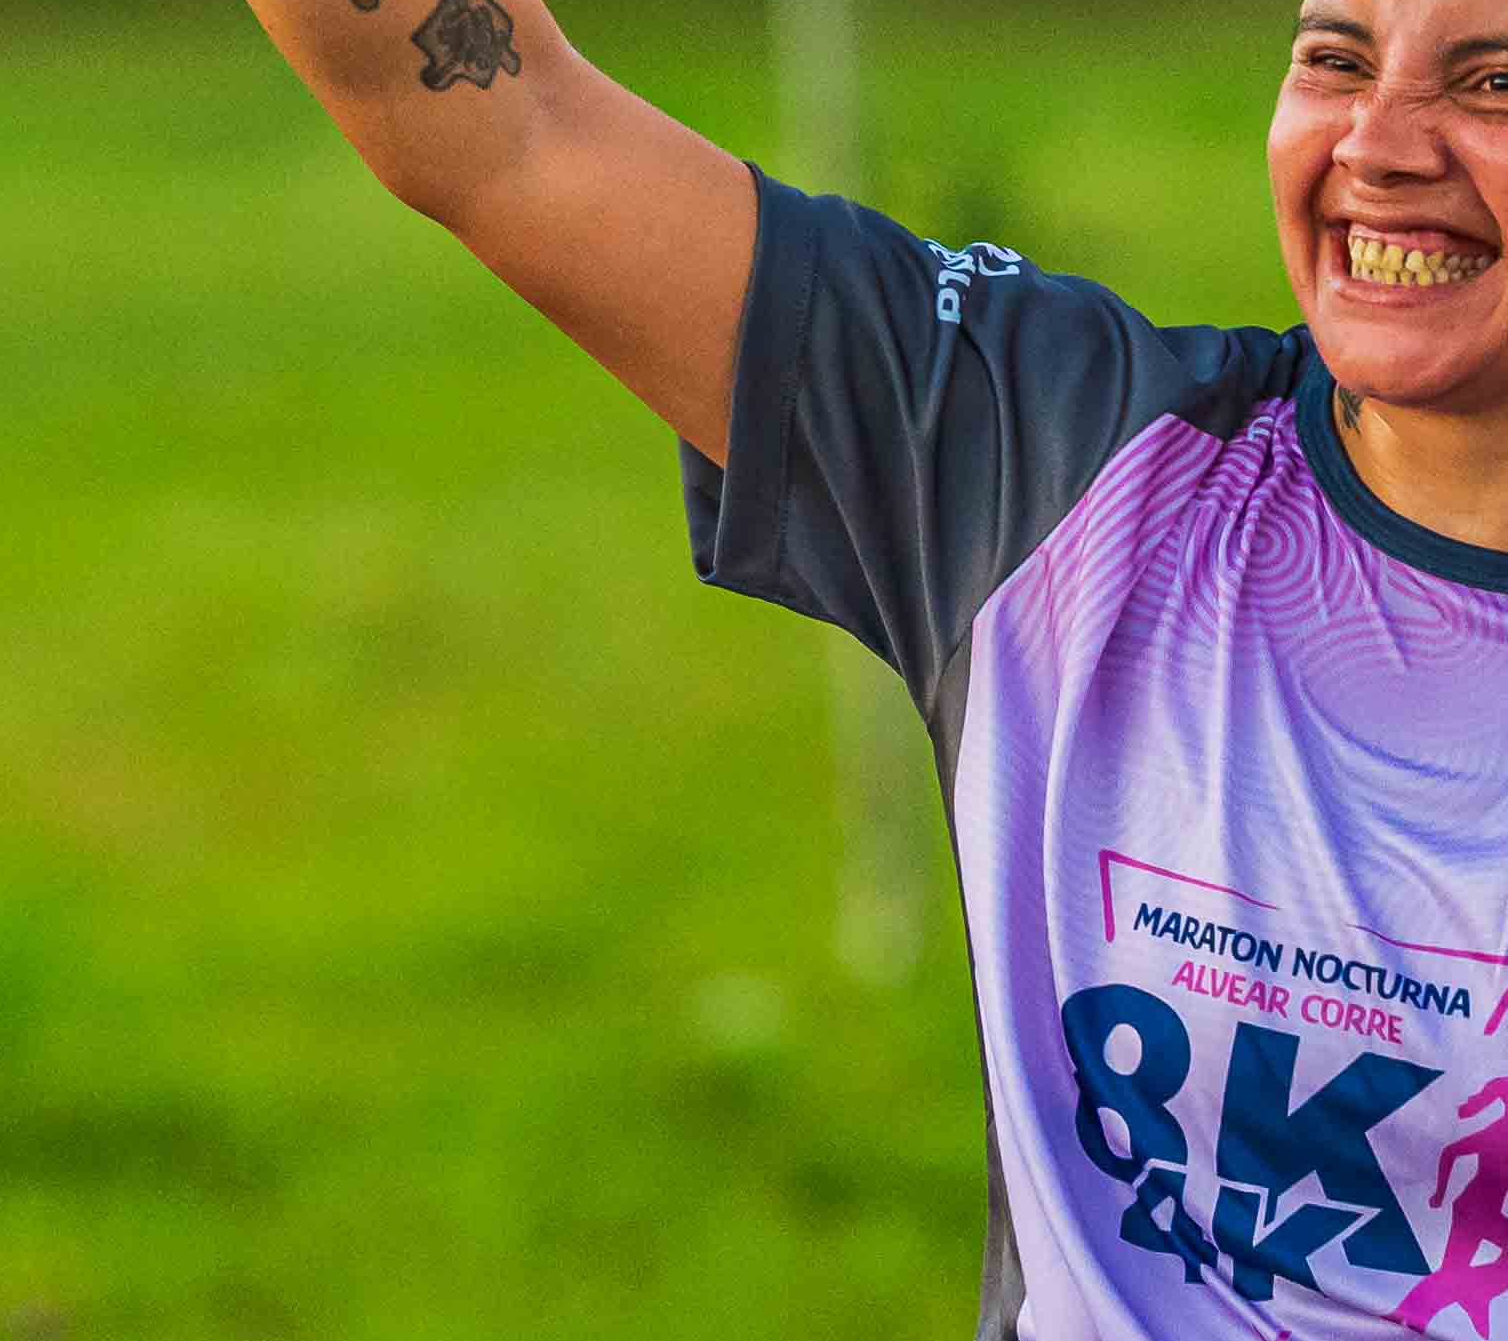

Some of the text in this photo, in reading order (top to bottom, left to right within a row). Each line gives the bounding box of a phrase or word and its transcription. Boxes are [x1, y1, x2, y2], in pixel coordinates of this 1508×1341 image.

[1133, 902, 1472, 1020] MARATON NOCTURNA
[1172, 960, 1404, 1046] ALVEAR CORRE
[1061, 983, 1445, 1277] 8K
[1118, 1166, 1364, 1303] 4K
